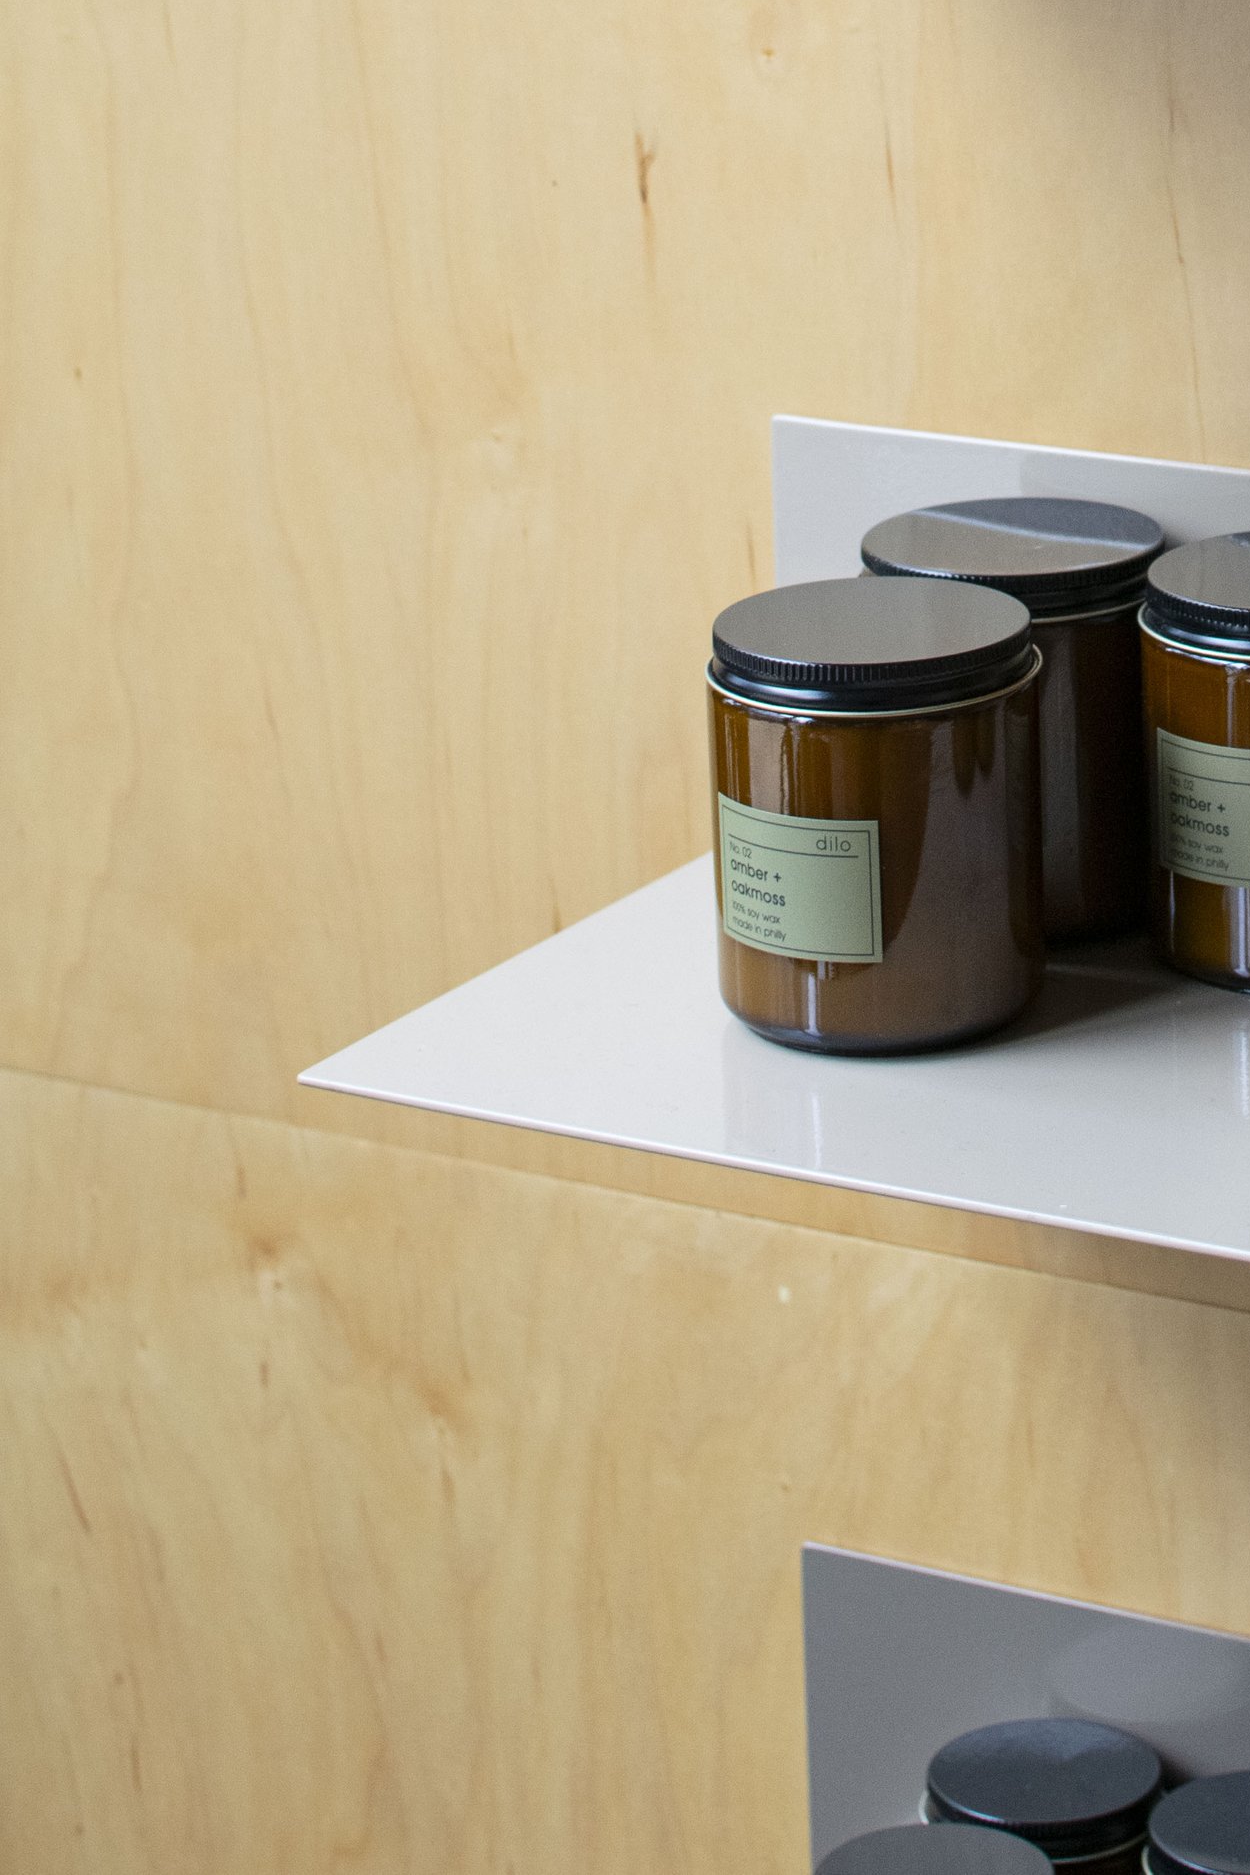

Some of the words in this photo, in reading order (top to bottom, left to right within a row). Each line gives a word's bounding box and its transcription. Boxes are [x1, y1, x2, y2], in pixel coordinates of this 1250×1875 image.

[1169, 791, 1212, 812] amber
[1218, 803, 1226, 813] +
[1170, 812, 1230, 837] oakmoss
[816, 835, 851, 852] dilo
[1204, 843, 1223, 854] wax
[730, 858, 768, 881] amber
[773, 873, 782, 882] +
[732, 879, 786, 907] oakmoss
[762, 913, 780, 923] wax
